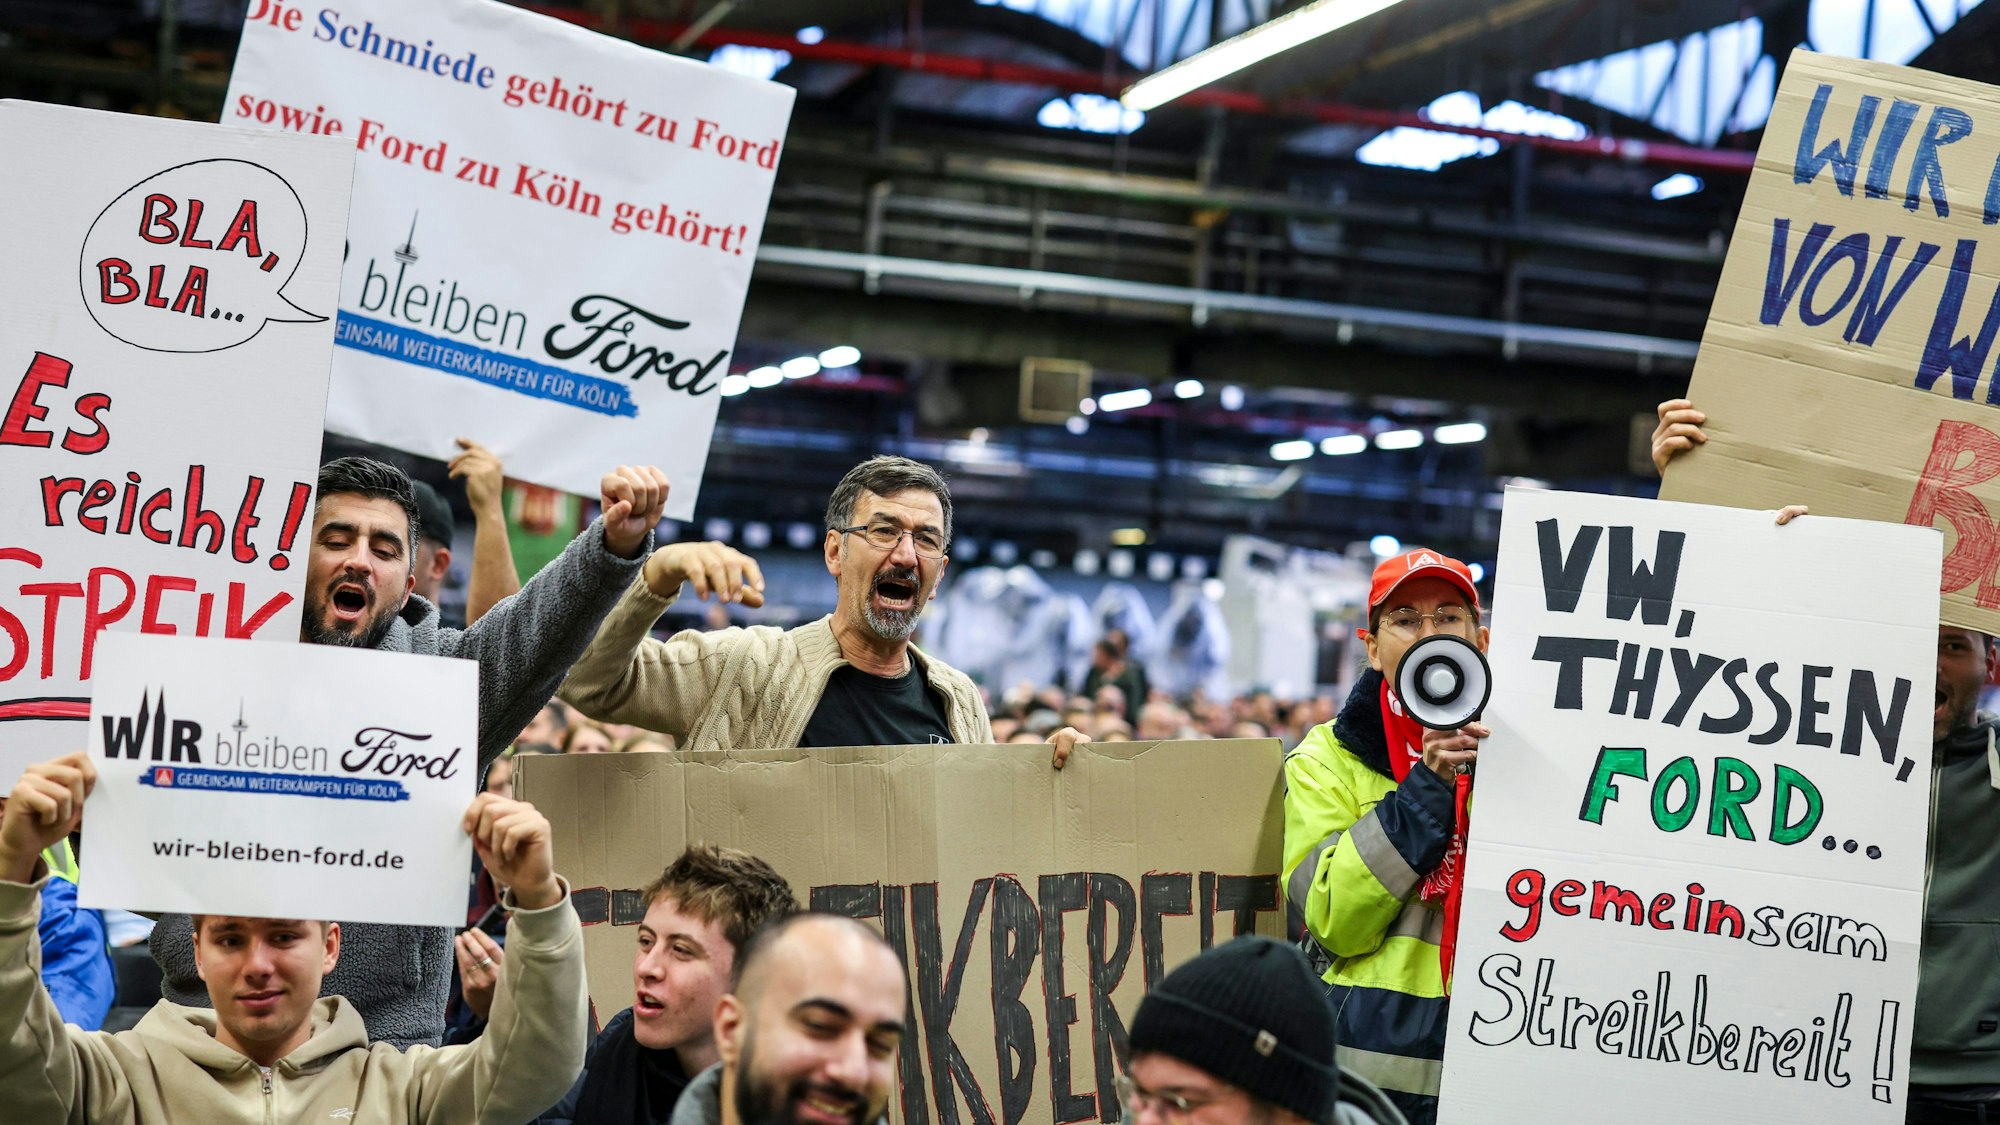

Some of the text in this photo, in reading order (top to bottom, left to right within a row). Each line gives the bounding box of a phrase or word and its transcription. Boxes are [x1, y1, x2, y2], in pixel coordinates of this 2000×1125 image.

[313, 8, 495, 89] Schmiede
[504, 71, 627, 128] gehört
[634, 112, 677, 145] zu
[688, 117, 780, 171] Ford
[236, 92, 747, 256] sowie Ford zu Köln gehört!
[1794, 84, 1973, 217] WIR
[139, 193, 280, 272] BLA,
[97, 258, 244, 322] BLA...
[360, 252, 729, 396] bleiben Ford
[1759, 218, 2000, 407] VON W
[0, 351, 111, 455] Es
[335, 320, 621, 411] EINSAM WEITERKÄMPFEN FÜR KÖLN
[40, 465, 312, 571] reicht!
[1536, 518, 1696, 638] VW,
[101, 685, 462, 780] WIR bleiben Ford
[1532, 636, 1915, 783] THYSSEN,
[177, 772, 397, 799] GEMEINSAM WEITERKÄMPFEN FÜR KÖLN
[1579, 746, 1882, 860] FORD...
[153, 838, 404, 869] wir-bleiben-ford.de
[1499, 869, 1887, 961] gemeinsam
